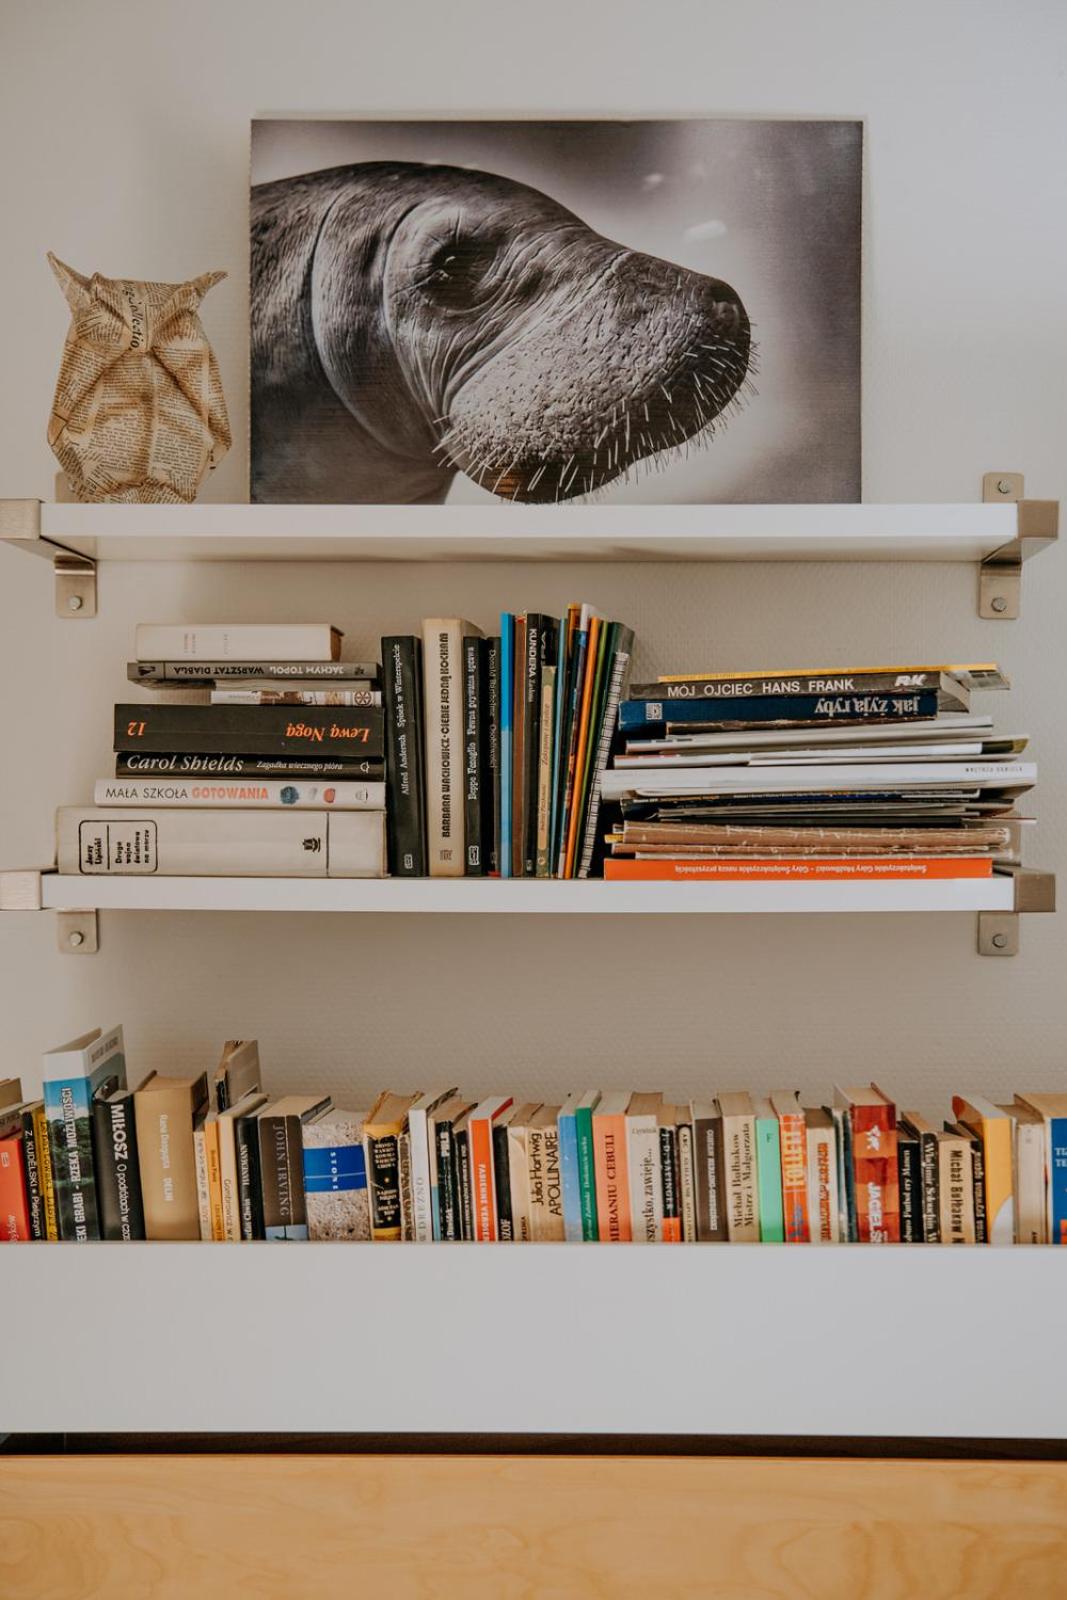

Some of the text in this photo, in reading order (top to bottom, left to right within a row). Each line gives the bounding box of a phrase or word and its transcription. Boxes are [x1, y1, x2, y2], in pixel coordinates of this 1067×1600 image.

[439, 633, 449, 674] KOCHAM
[529, 628, 537, 677] KUNDERA
[213, 666, 264, 675] WARSZTAT
[440, 675, 451, 703] JEDNĄ
[667, 679, 854, 697] MÓJ OJCIEC HANS FRANK
[396, 704, 406, 727] Spisek
[814, 696, 920, 717] jak żyją ryby
[127, 721, 147, 736] 12
[286, 723, 369, 743] Lewą Nogą
[467, 711, 476, 735] Pewna
[127, 754, 244, 771] Carol Shields
[399, 735, 409, 795] Alfred Andersch
[441, 738, 450, 792] WACHOWICZ
[467, 742, 478, 800] Beppe Fenoglio
[105, 787, 268, 799] MAŁA SZKOŁA GOTOWANIA
[441, 794, 451, 838] BARBARA
[85, 845, 94, 865] Jerzy
[115, 842, 123, 863] Druga
[144, 854, 149, 863] na
[790, 865, 809, 874] Góry
[855, 865, 873, 873] Góry
[61, 1087, 78, 1148] MOŻLIWOŚCI
[110, 1104, 128, 1160] MIŁOSZ
[67, 1151, 81, 1181] RZEKA
[240, 1144, 250, 1185] HANEMANN
[605, 1134, 616, 1180] CEBULI
[663, 1145, 670, 1156] D.
[731, 1134, 742, 1187] Bułhakow
[741, 1123, 752, 1181] Małgorzata
[902, 1150, 910, 1177] Manen
[950, 1150, 964, 1182] Michał
[24, 1130, 41, 1236] Z. KUDELSKI Pielgrzym
[116, 1164, 127, 1172] O
[273, 1125, 289, 1216] JOHN IRVING
[330, 1152, 338, 1190] STONE
[529, 1133, 544, 1206] Julia Hartwig
[545, 1131, 562, 1216] APOLLINAIRE
[640, 1148, 655, 1196] zawieje...
[115, 1173, 130, 1214] podróżach
[664, 1160, 674, 1210] SALINGER
[904, 1179, 912, 1191] ery
[73, 1193, 85, 1222] GRABI
[243, 1198, 252, 1220] Chwin
[745, 1191, 754, 1226] Mistrz
[902, 1192, 912, 1218] Futbol
[950, 1186, 965, 1233] Bułhakow
